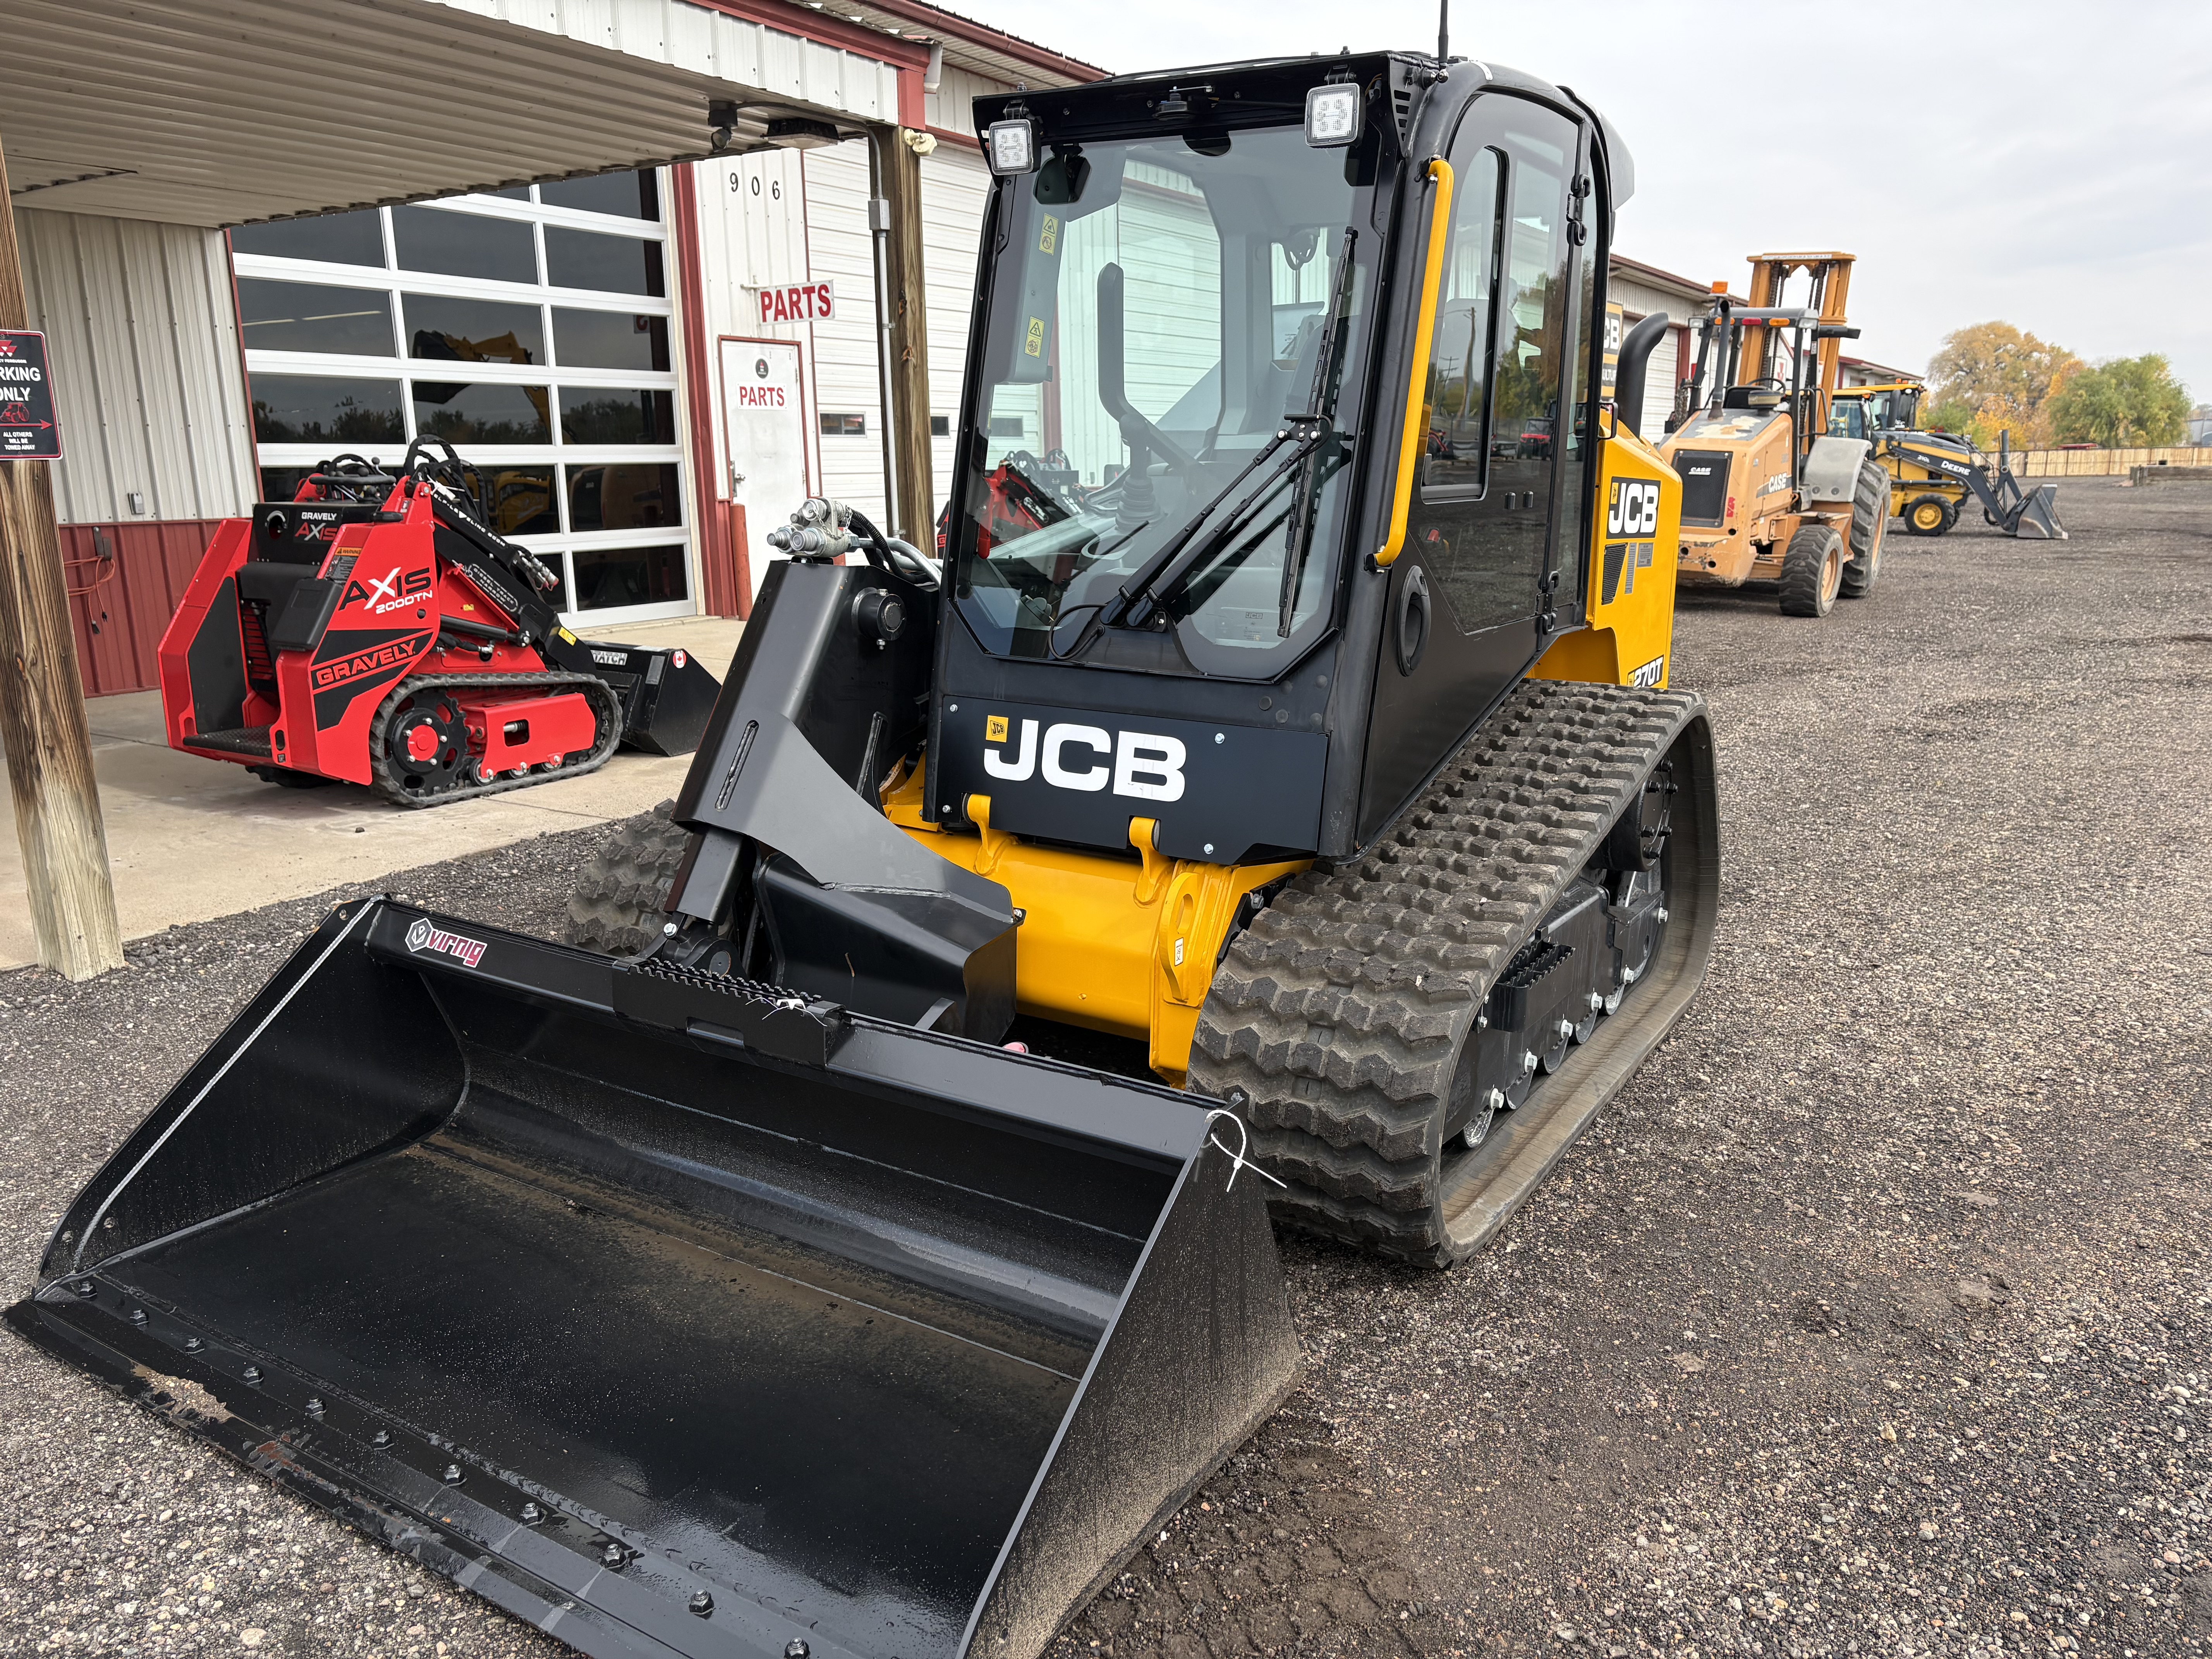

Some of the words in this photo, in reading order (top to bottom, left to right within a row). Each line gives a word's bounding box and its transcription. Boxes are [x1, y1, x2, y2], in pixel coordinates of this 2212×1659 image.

[760, 284, 831, 323] PARTS
[739, 386, 785, 407] PARTS
[1941, 460, 1971, 476] DEERE
[1769, 472, 1787, 493] CASE
[301, 512, 337, 521] GRAVELY
[1609, 483, 1659, 533] JCB
[295, 522, 338, 541] AXIS
[488, 532, 506, 546] BOOM
[338, 567, 431, 611] AXIS
[473, 568, 493, 587] DIESEL
[496, 587, 514, 605] TRACK
[480, 579, 506, 602] NARROW
[316, 640, 416, 685] GRAVELY
[592, 651, 627, 665] TATCH
[1633, 656, 1663, 688] 270T
[992, 722, 1004, 734] JCB
[984, 719, 1186, 802] JCB
